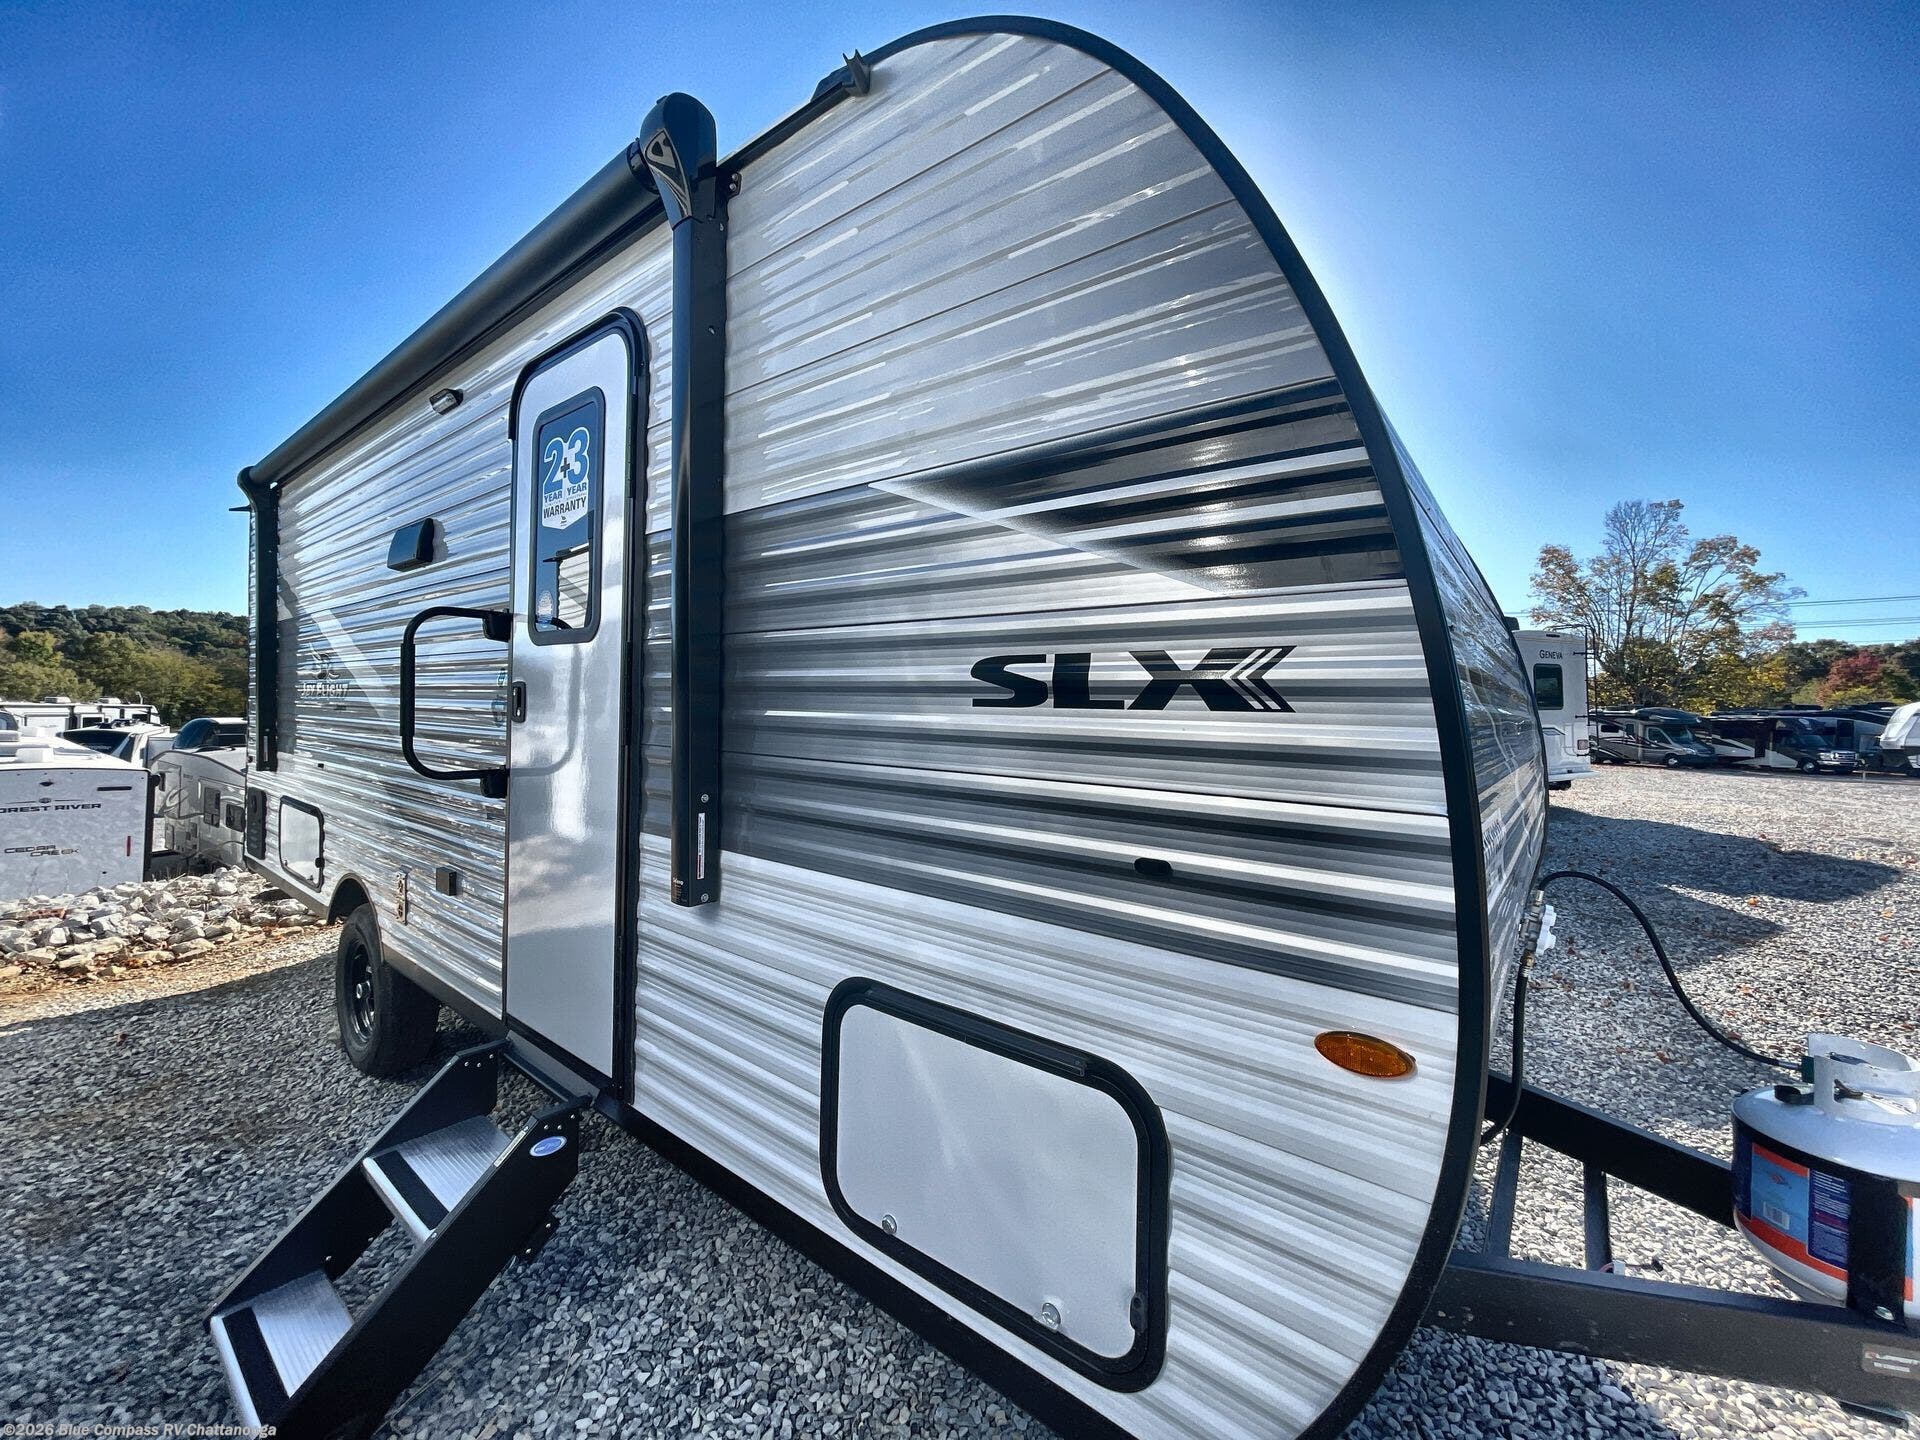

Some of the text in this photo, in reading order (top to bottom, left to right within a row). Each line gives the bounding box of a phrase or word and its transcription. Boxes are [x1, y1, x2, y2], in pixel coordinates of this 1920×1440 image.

[544, 490, 563, 503] YEAR
[567, 482, 588, 496] YEAR
[543, 496, 587, 519] WARRANTY
[970, 645, 1297, 713] SLX
[54, 803, 102, 811] RIVER
[4, 845, 56, 854] CEDAR
